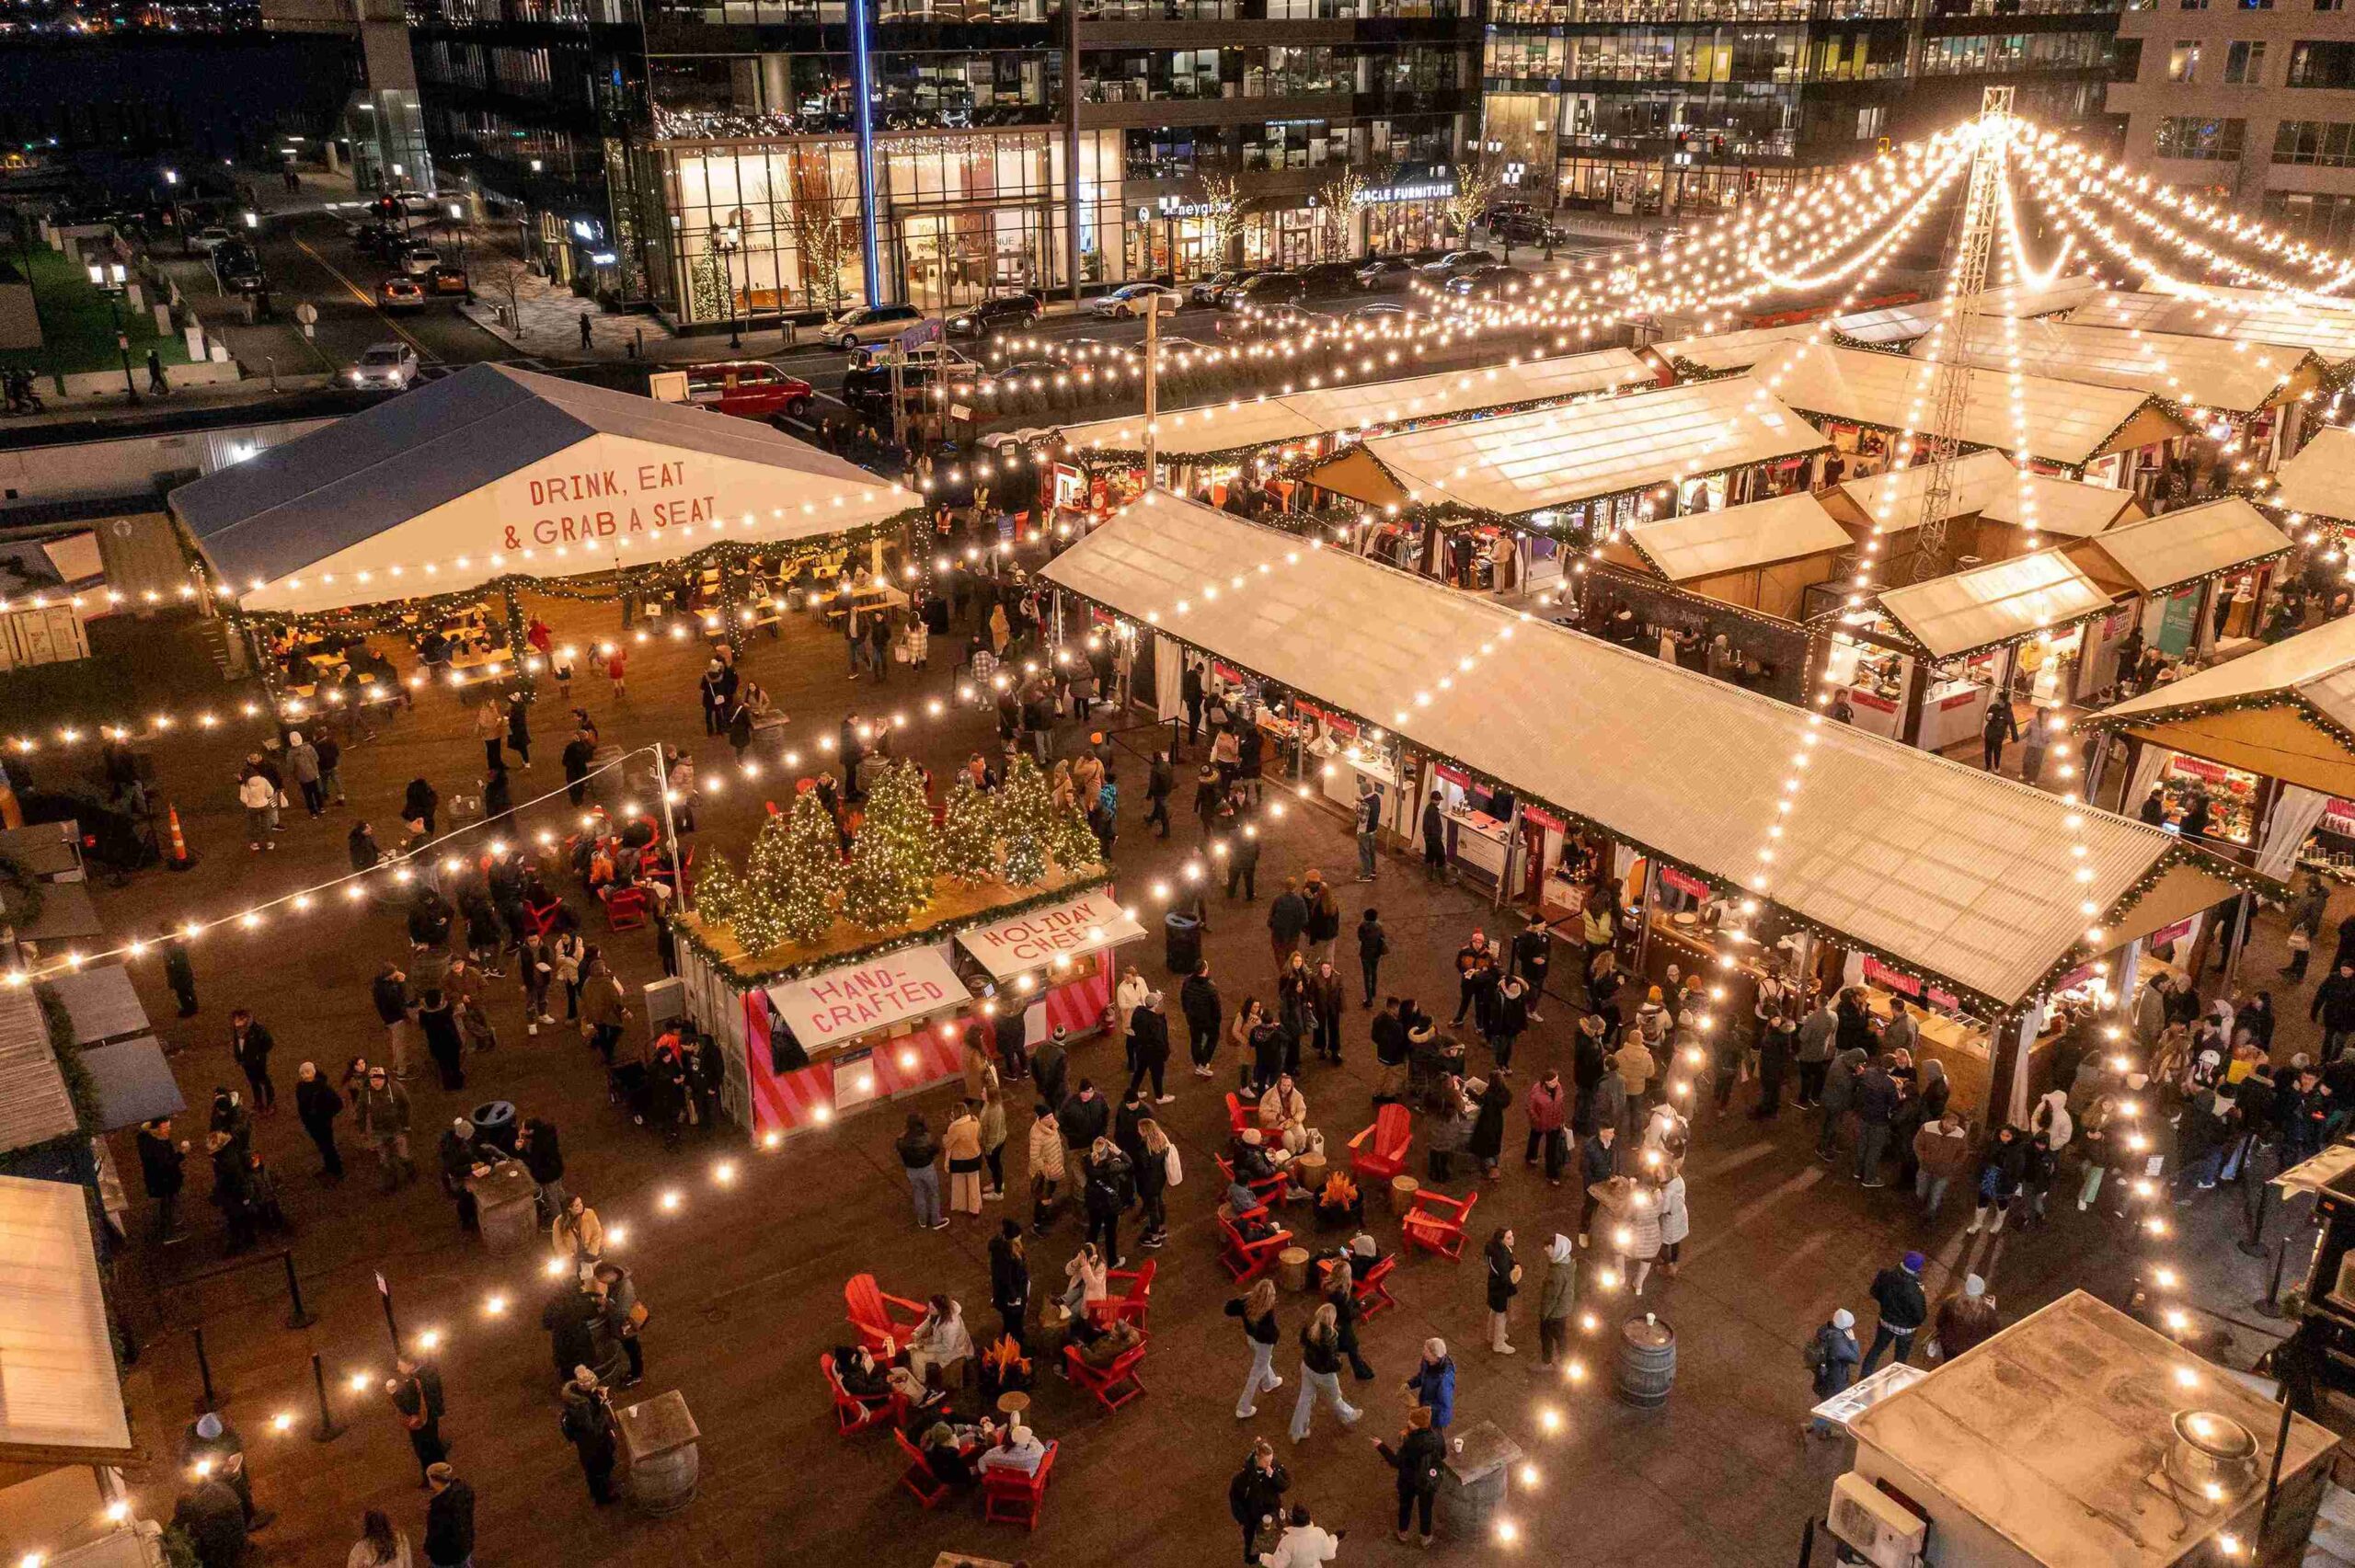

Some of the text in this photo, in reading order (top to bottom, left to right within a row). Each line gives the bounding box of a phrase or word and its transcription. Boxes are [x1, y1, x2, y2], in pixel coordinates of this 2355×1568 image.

[1162, 200, 1233, 218] neygrow
[1352, 184, 1453, 204] CIRCLE FURNITURE
[530, 461, 684, 506] DRINK, EAT
[504, 496, 715, 550] & GRAB A SEAT
[982, 903, 1097, 947] HOLIDAY
[810, 969, 906, 1004] HAND-
[811, 981, 944, 1033] CRAFTED
